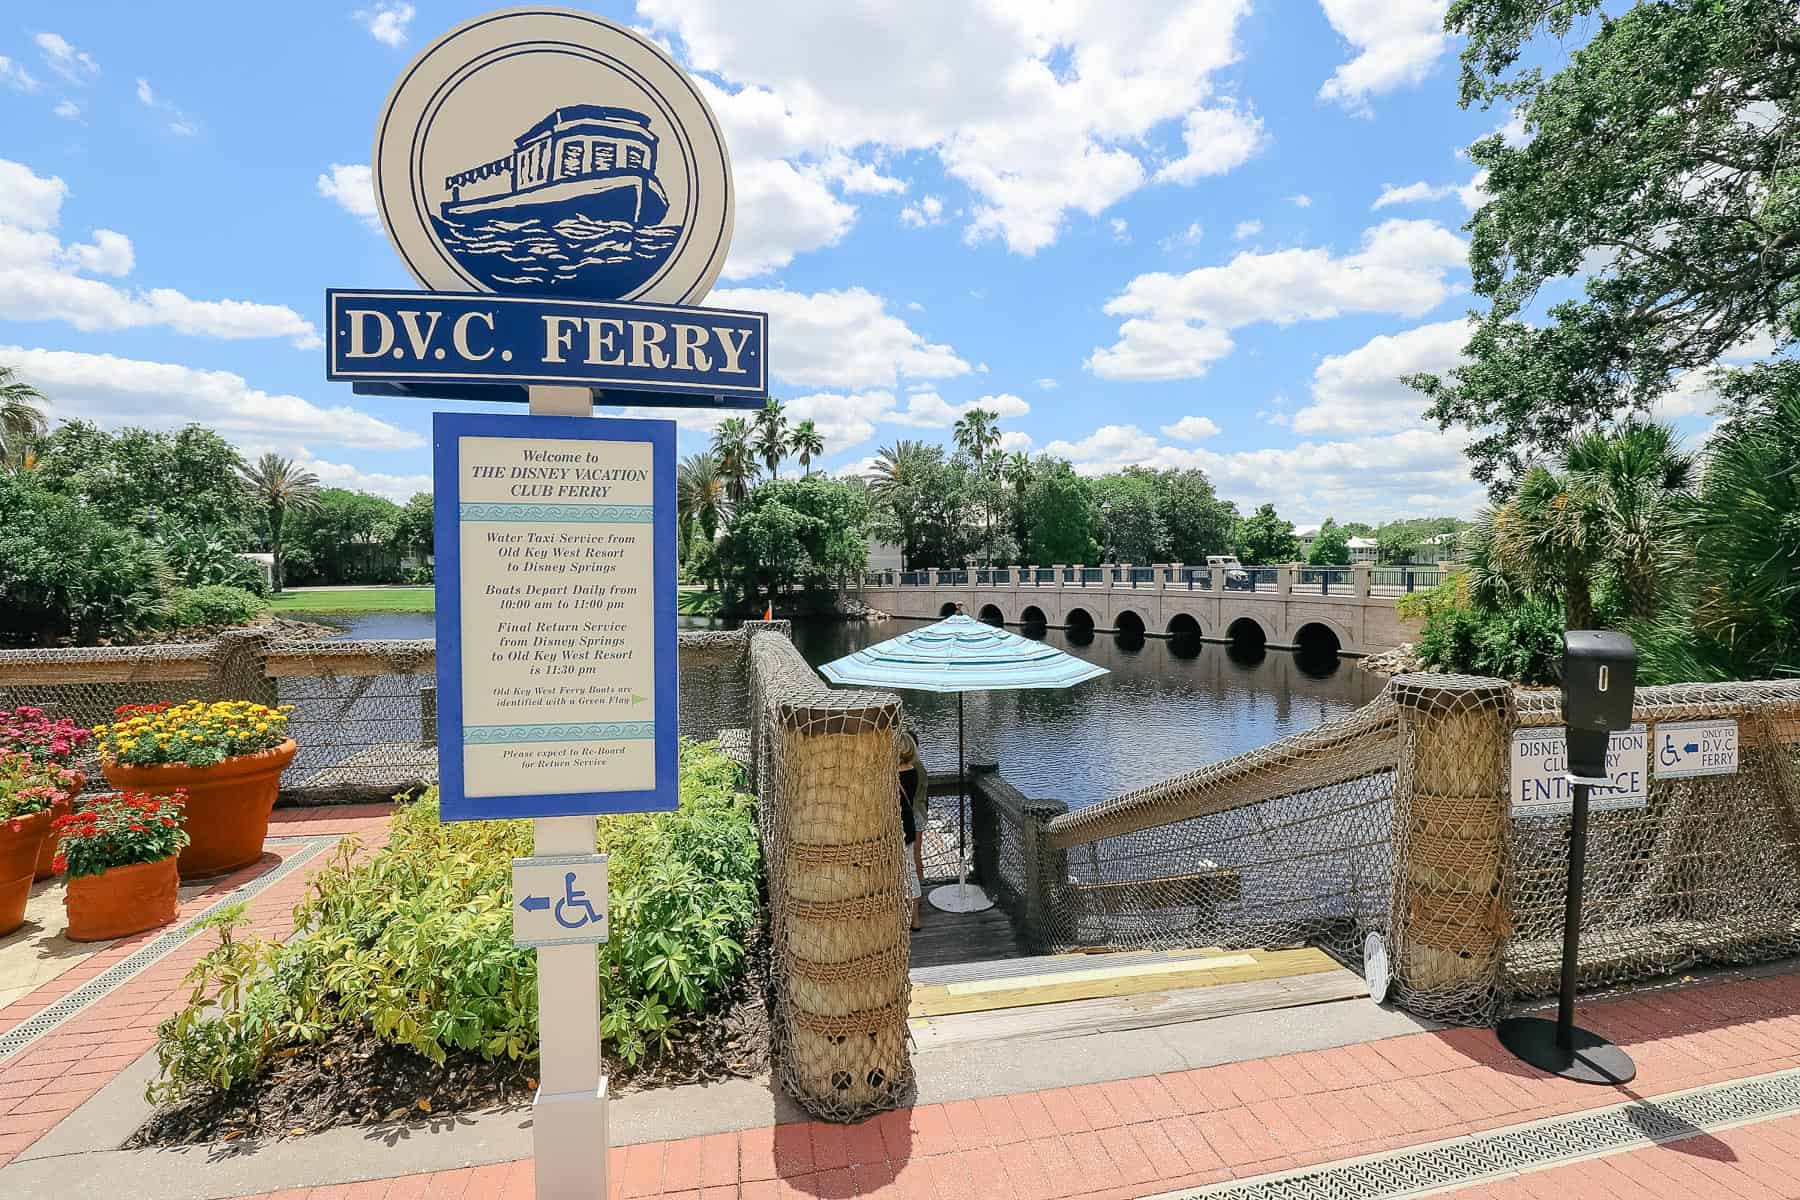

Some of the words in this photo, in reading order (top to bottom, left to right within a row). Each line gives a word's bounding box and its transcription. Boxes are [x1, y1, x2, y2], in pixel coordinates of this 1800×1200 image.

[345, 310, 513, 362] D.V.C.
[541, 315, 753, 374] FERRY
[523, 450, 582, 464] Welcome
[586, 451, 599, 464] to
[471, 466, 506, 479] THE
[510, 467, 571, 480] DISNEY
[575, 468, 649, 482] VACATION
[511, 484, 553, 497] CLUB
[558, 485, 611, 498] FERRY
[487, 532, 523, 543] Water
[527, 533, 555, 543] Taxi
[559, 533, 604, 544] Service
[607, 534, 636, 544] from
[498, 547, 520, 557] Old
[525, 547, 548, 559] Key
[553, 548, 581, 558] West
[585, 548, 625, 558] Resort
[507, 562, 519, 572] to
[524, 562, 566, 573] Disney
[570, 562, 616, 574] Springs
[485, 585, 521, 595] Boats
[526, 585, 568, 596] Depart
[572, 585, 606, 596] Daily
[609, 585, 638, 595] from
[500, 600, 530, 609] 10:00
[557, 600, 569, 609] to
[574, 600, 603, 609] 11:00
[606, 602, 625, 611] pm
[497, 622, 532, 632] Final
[536, 622, 579, 632] Return
[583, 621, 627, 632] Service
[500, 637, 528, 647] from
[533, 636, 575, 647] Disney
[578, 636, 625, 648] Springs
[491, 652, 503, 662] to
[508, 651, 530, 661] Old
[534, 650, 557, 662] Key
[562, 650, 589, 660] West
[594, 650, 633, 660] Resort
[530, 665, 541, 675] is
[545, 665, 575, 675] 11:30
[577, 667, 596, 676] pm
[493, 687, 510, 696] Old
[513, 687, 531, 697] Key
[534, 687, 556, 695] West
[559, 686, 586, 697] Ferry
[589, 685, 615, 694] Boats
[496, 697, 543, 707] identified
[545, 697, 567, 706] with
[578, 697, 606, 706] Green
[608, 696, 630, 706] Flag
[1702, 728, 1724, 739] ONLY
[1725, 728, 1735, 738] TO
[1702, 738, 1735, 753] D.V.C.
[503, 750, 534, 758] Please
[537, 749, 567, 759] expect
[570, 748, 579, 756] to
[521, 760, 535, 769] for
[538, 759, 570, 767] Return
[573, 758, 608, 767] Service
[1543, 757, 1568, 772] CLU
[1702, 753, 1734, 767] FERRY
